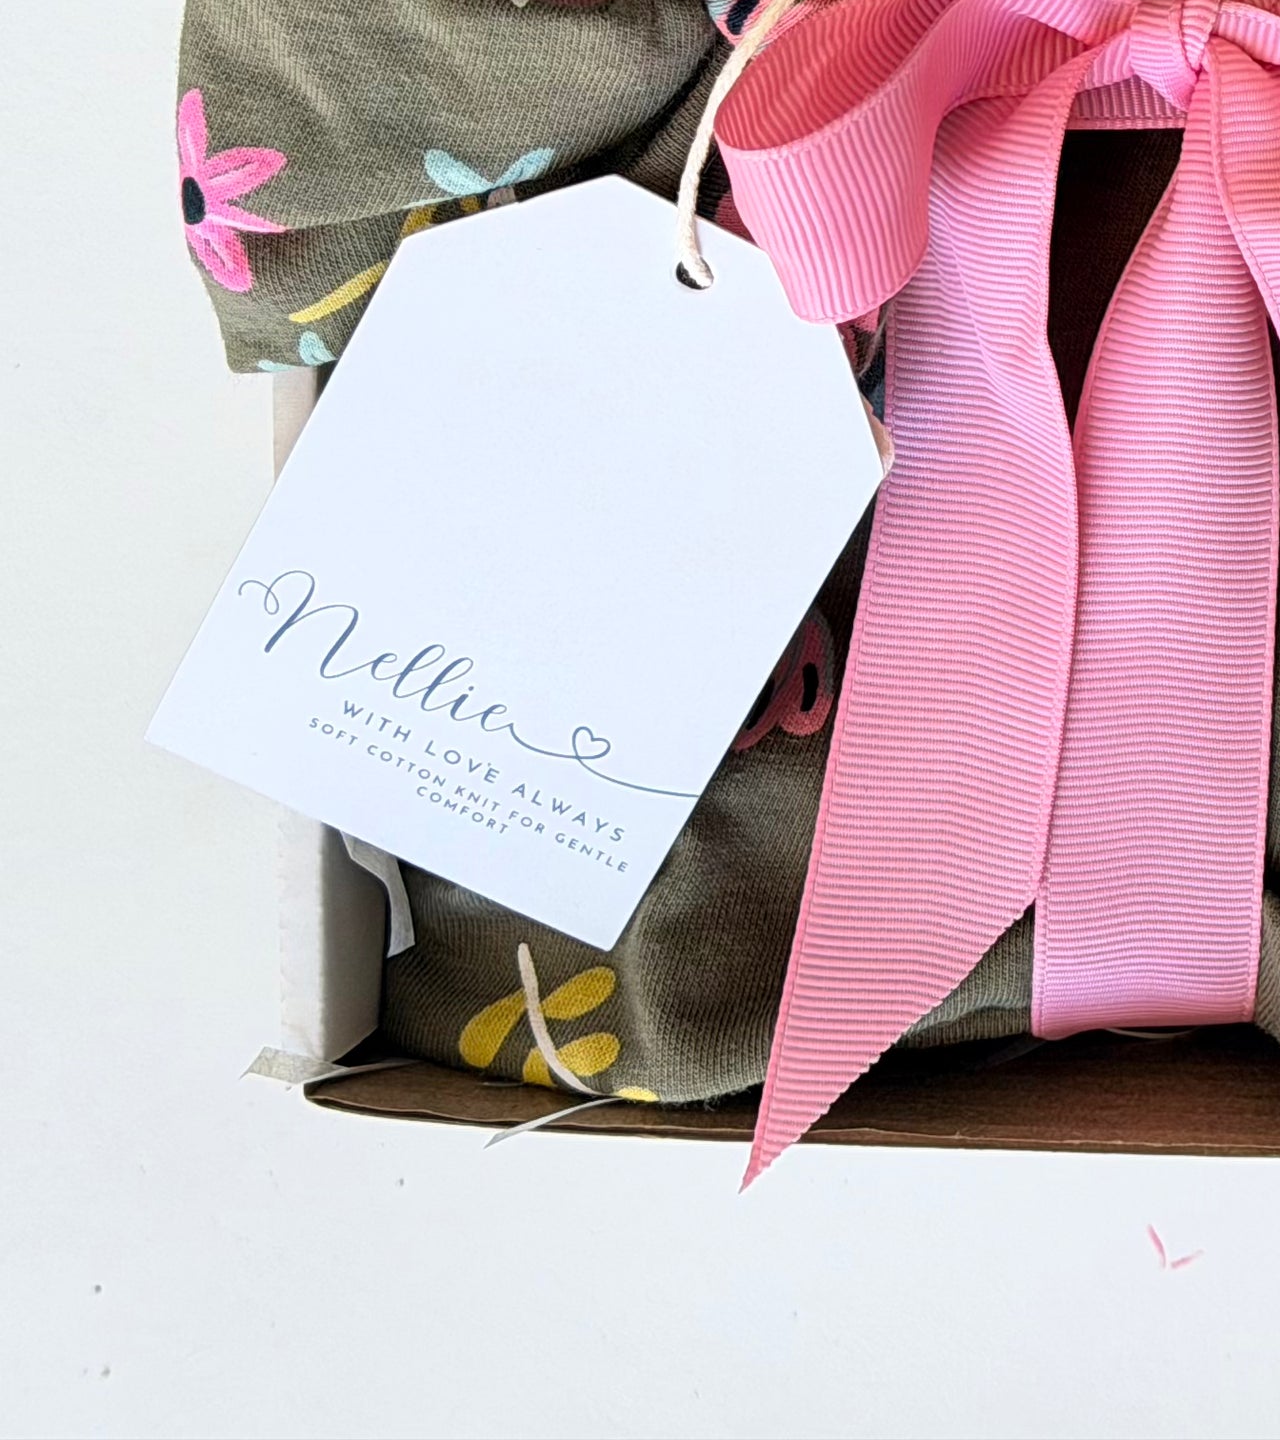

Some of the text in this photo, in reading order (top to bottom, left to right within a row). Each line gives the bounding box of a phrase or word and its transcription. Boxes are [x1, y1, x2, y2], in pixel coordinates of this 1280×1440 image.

[238, 570, 514, 732] Nellie
[309, 717, 630, 873] SOFT COTTON KNIT FOR GENTLE
[343, 699, 625, 842] WITH LOVE ALWAYS
[416, 786, 509, 835] COMFORT
